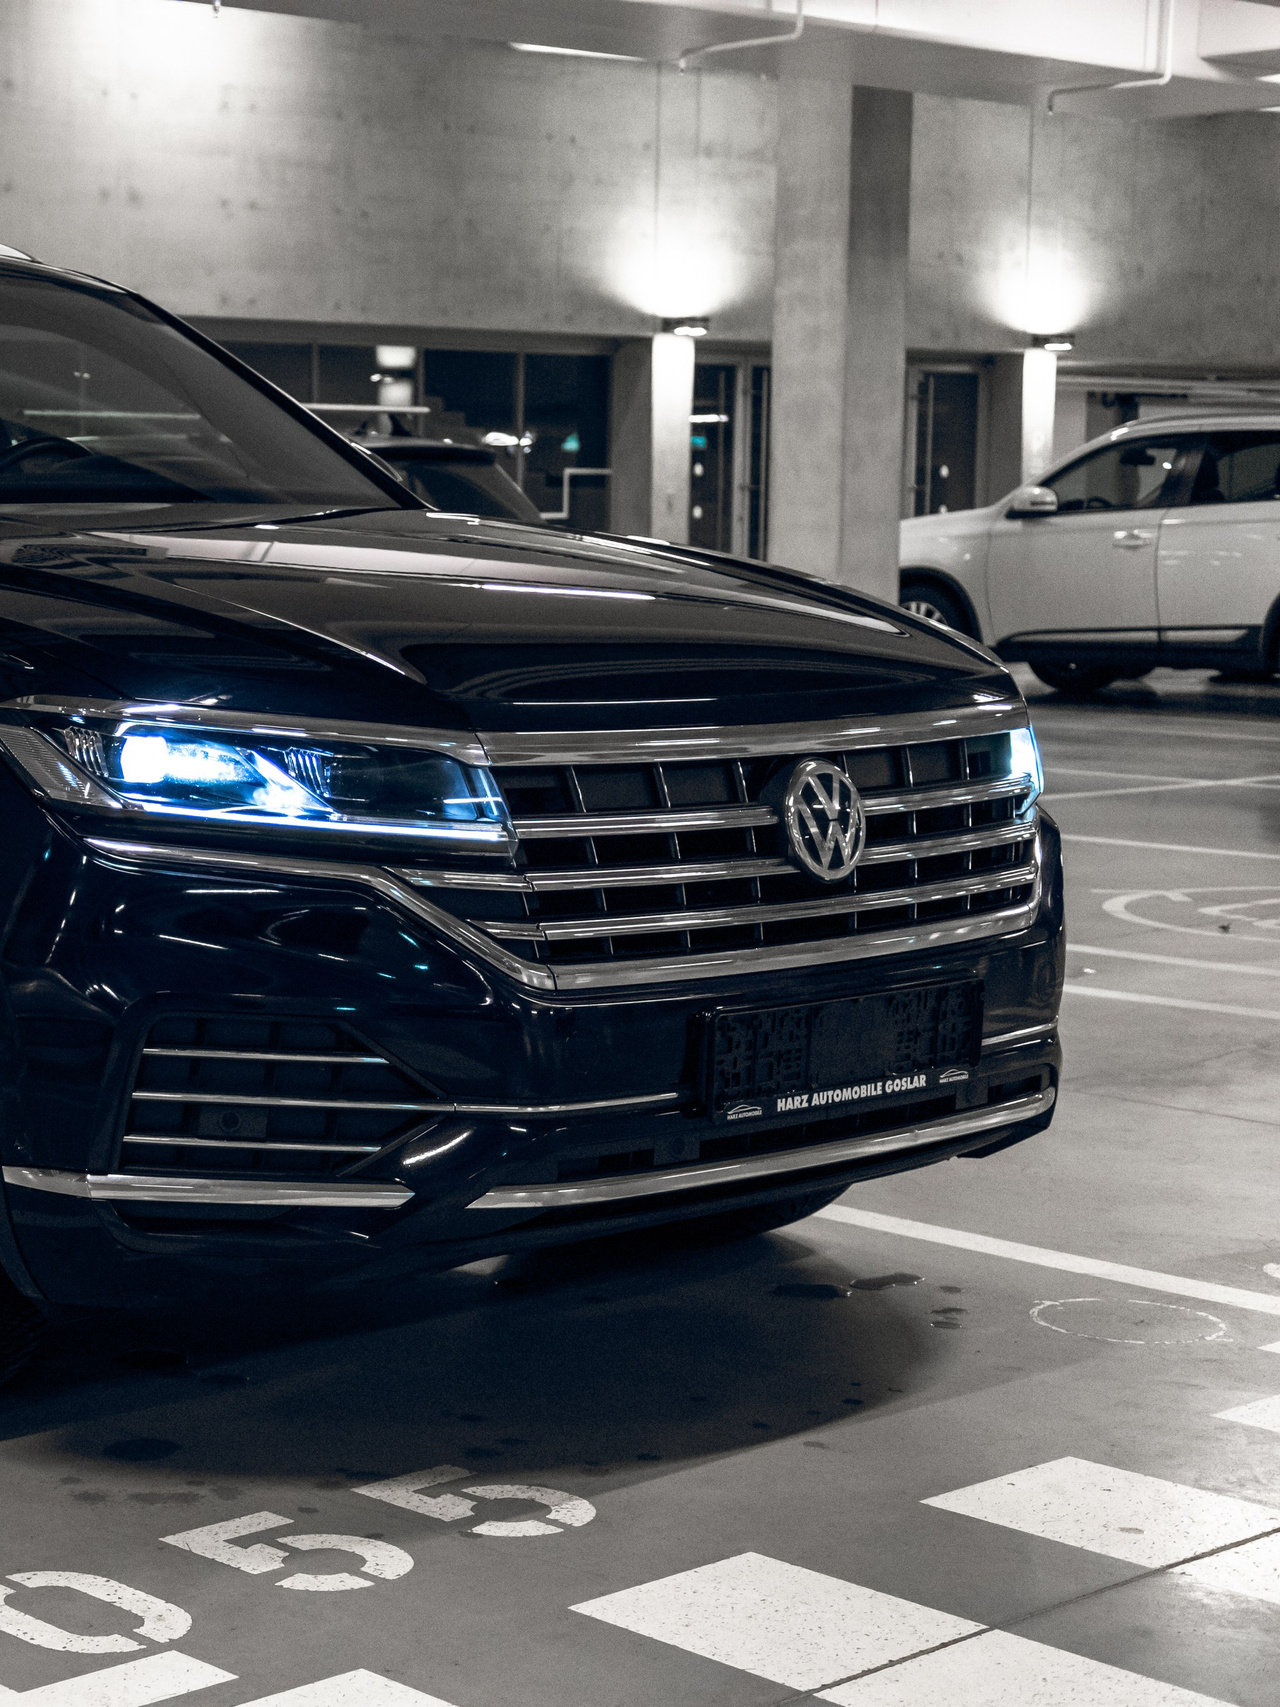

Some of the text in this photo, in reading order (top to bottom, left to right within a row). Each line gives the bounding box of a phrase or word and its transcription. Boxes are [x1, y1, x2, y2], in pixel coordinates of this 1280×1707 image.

[777, 1074, 927, 1111] HARZ AUTOMOBILE GOSLAR
